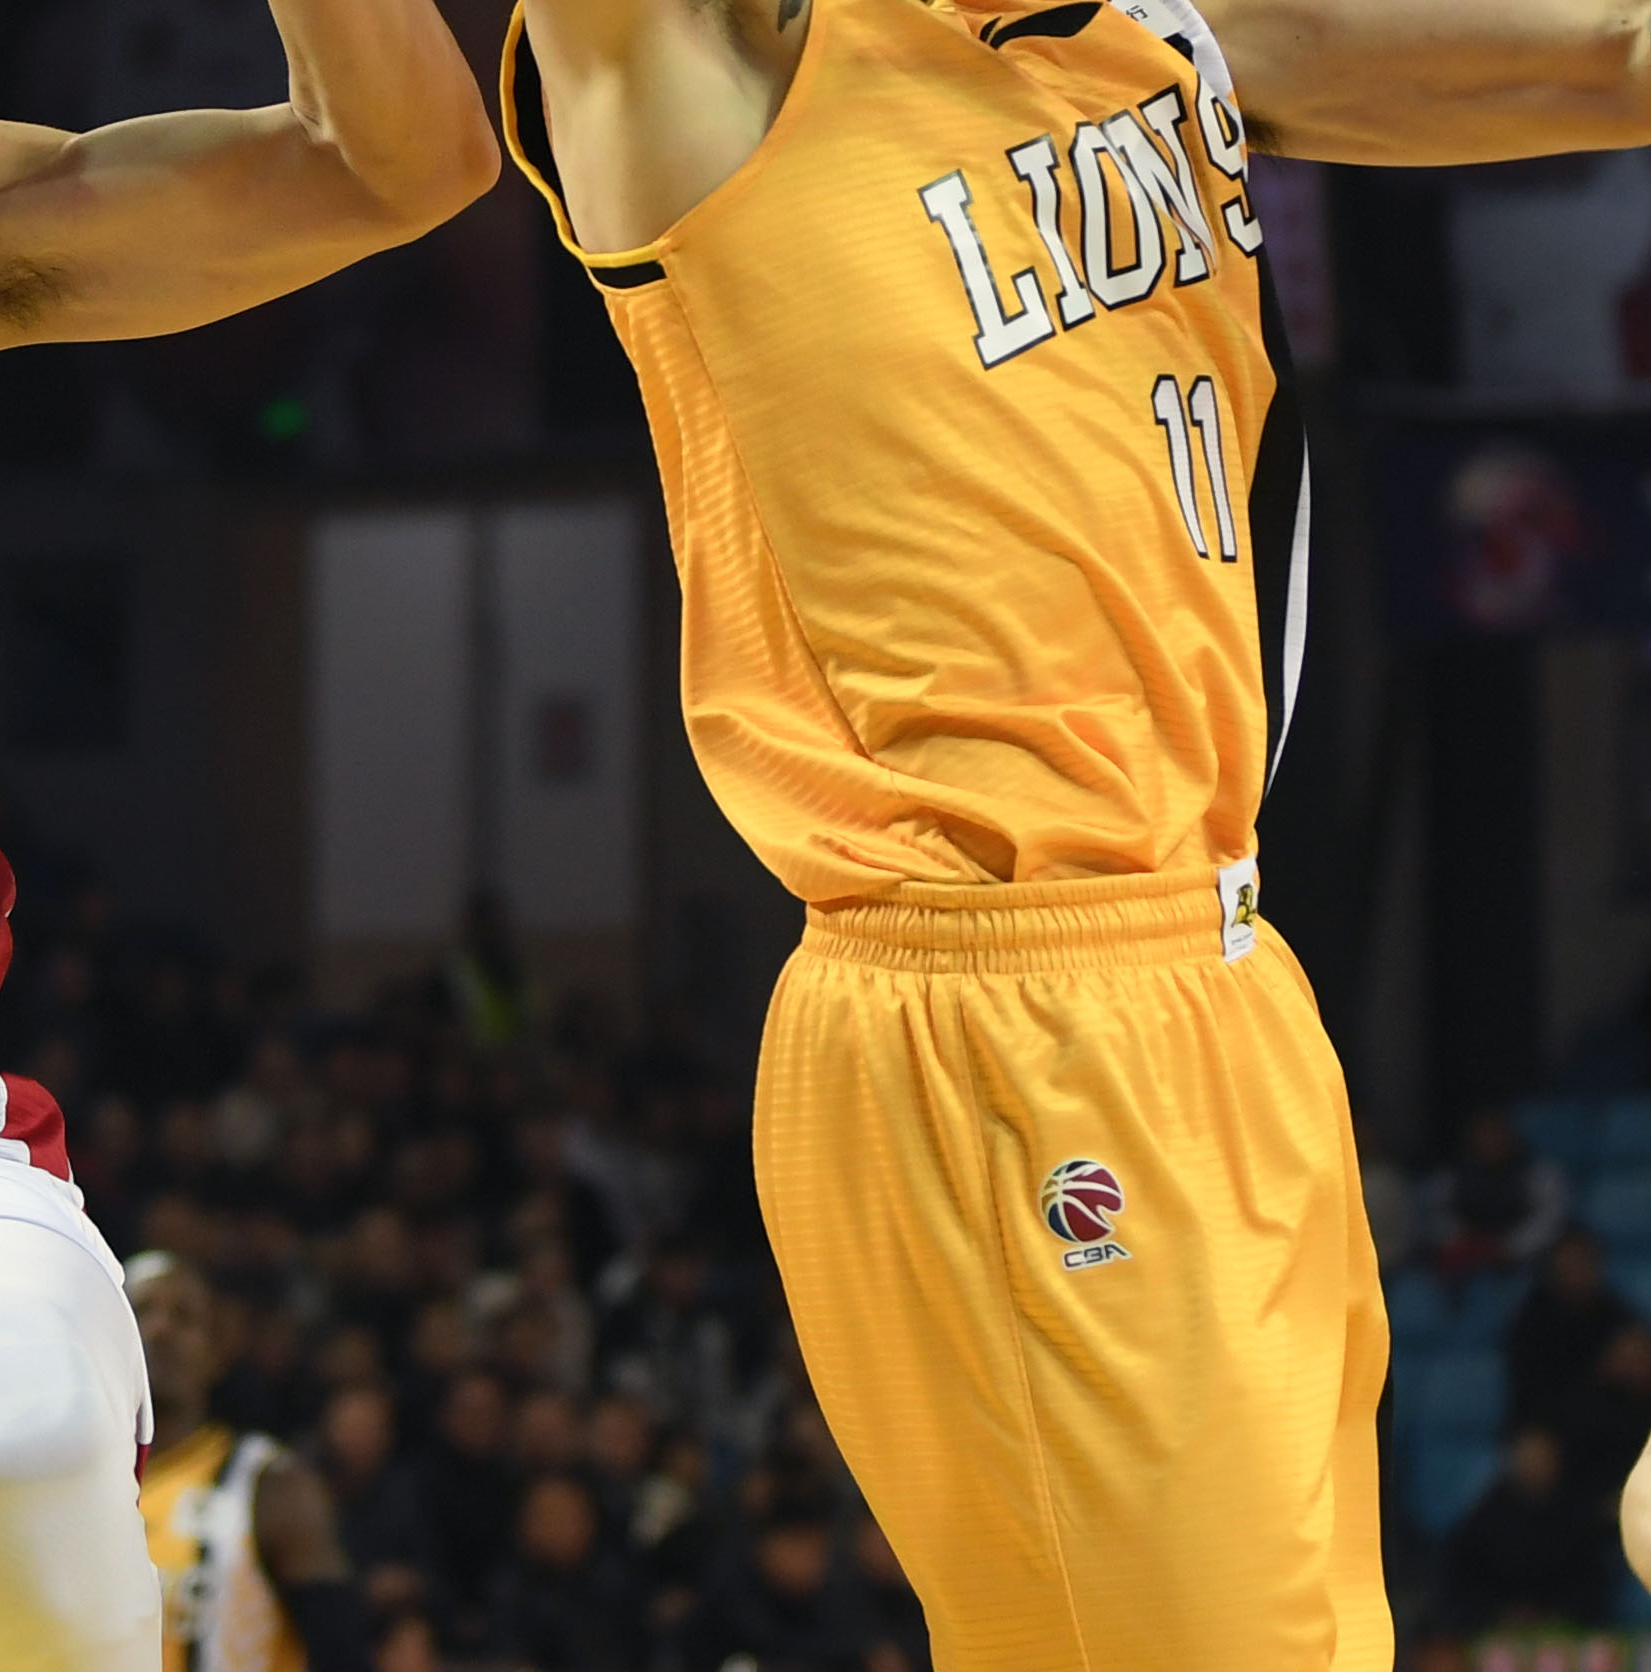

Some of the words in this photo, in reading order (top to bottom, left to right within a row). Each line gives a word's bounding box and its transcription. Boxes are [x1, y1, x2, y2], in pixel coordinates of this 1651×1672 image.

[917, 72, 1262, 369] LIONS
[1151, 374, 1237, 563] 11
[1064, 1243, 1128, 1268] CBA
